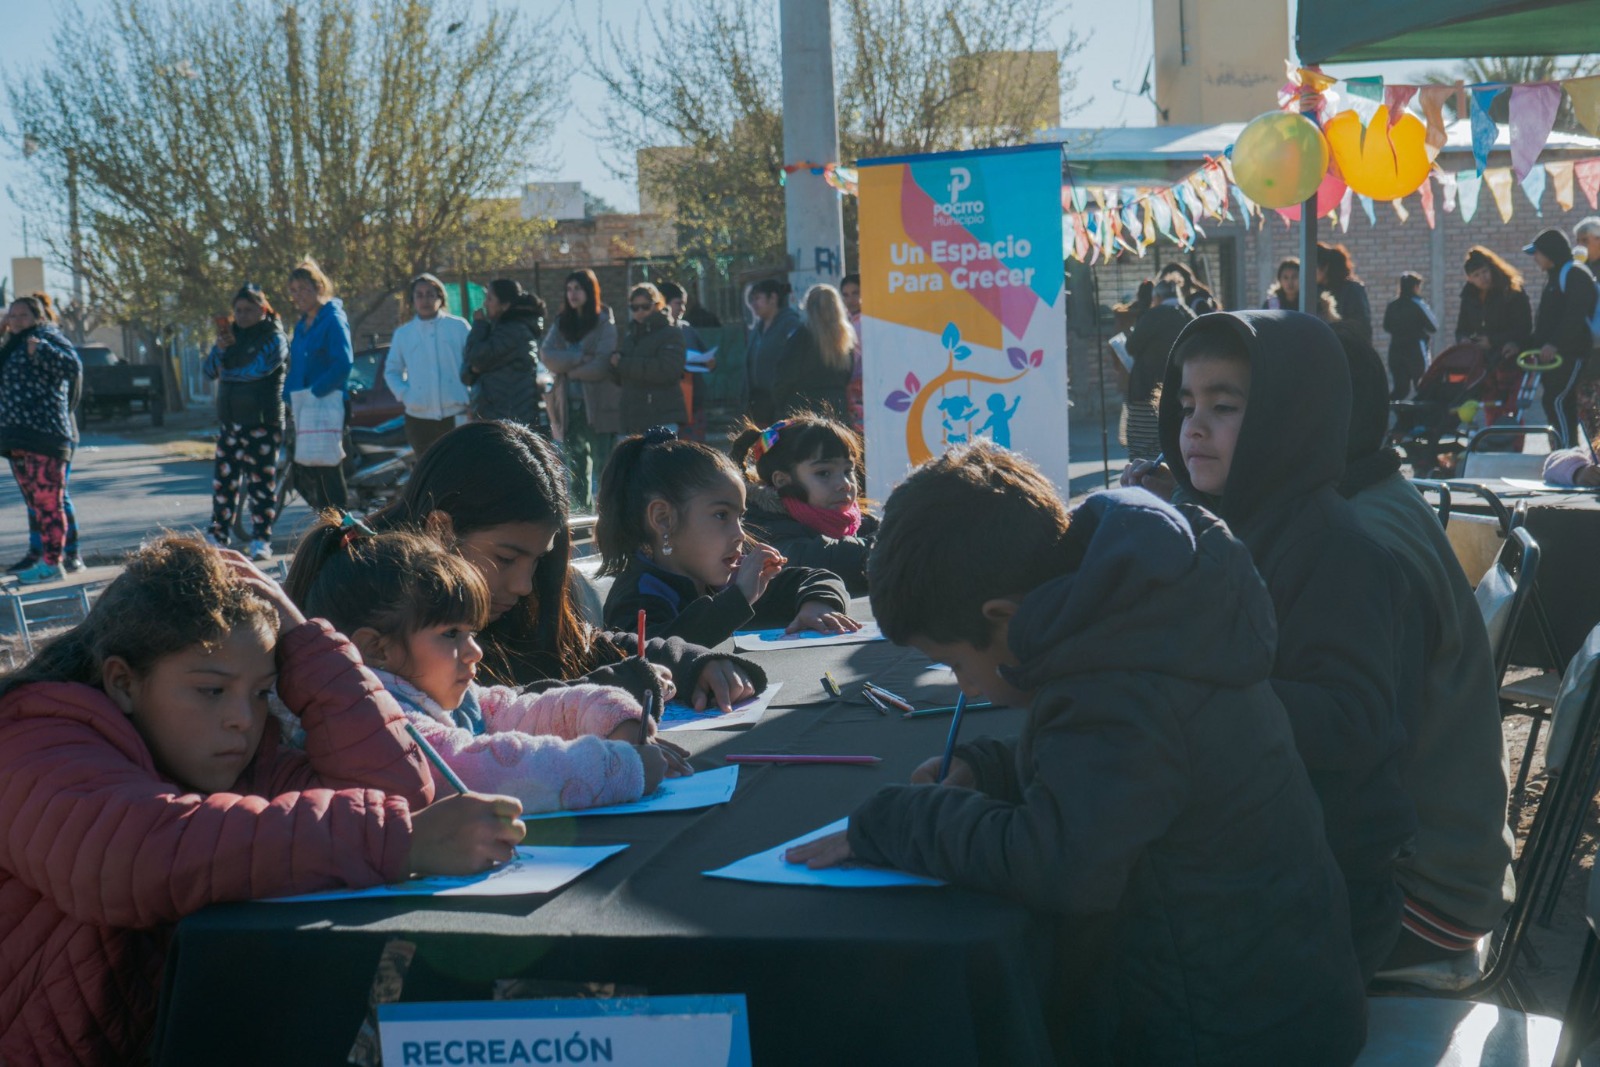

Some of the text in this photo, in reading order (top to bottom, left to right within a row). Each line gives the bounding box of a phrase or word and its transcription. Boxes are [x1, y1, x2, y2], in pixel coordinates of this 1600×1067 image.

[933, 201, 984, 216] POCITO
[933, 215, 985, 226] Municipio
[890, 235, 1032, 265] Un Espacio
[888, 267, 1035, 293] Para Crecer
[402, 1031, 613, 1066] RECREACIÓN
